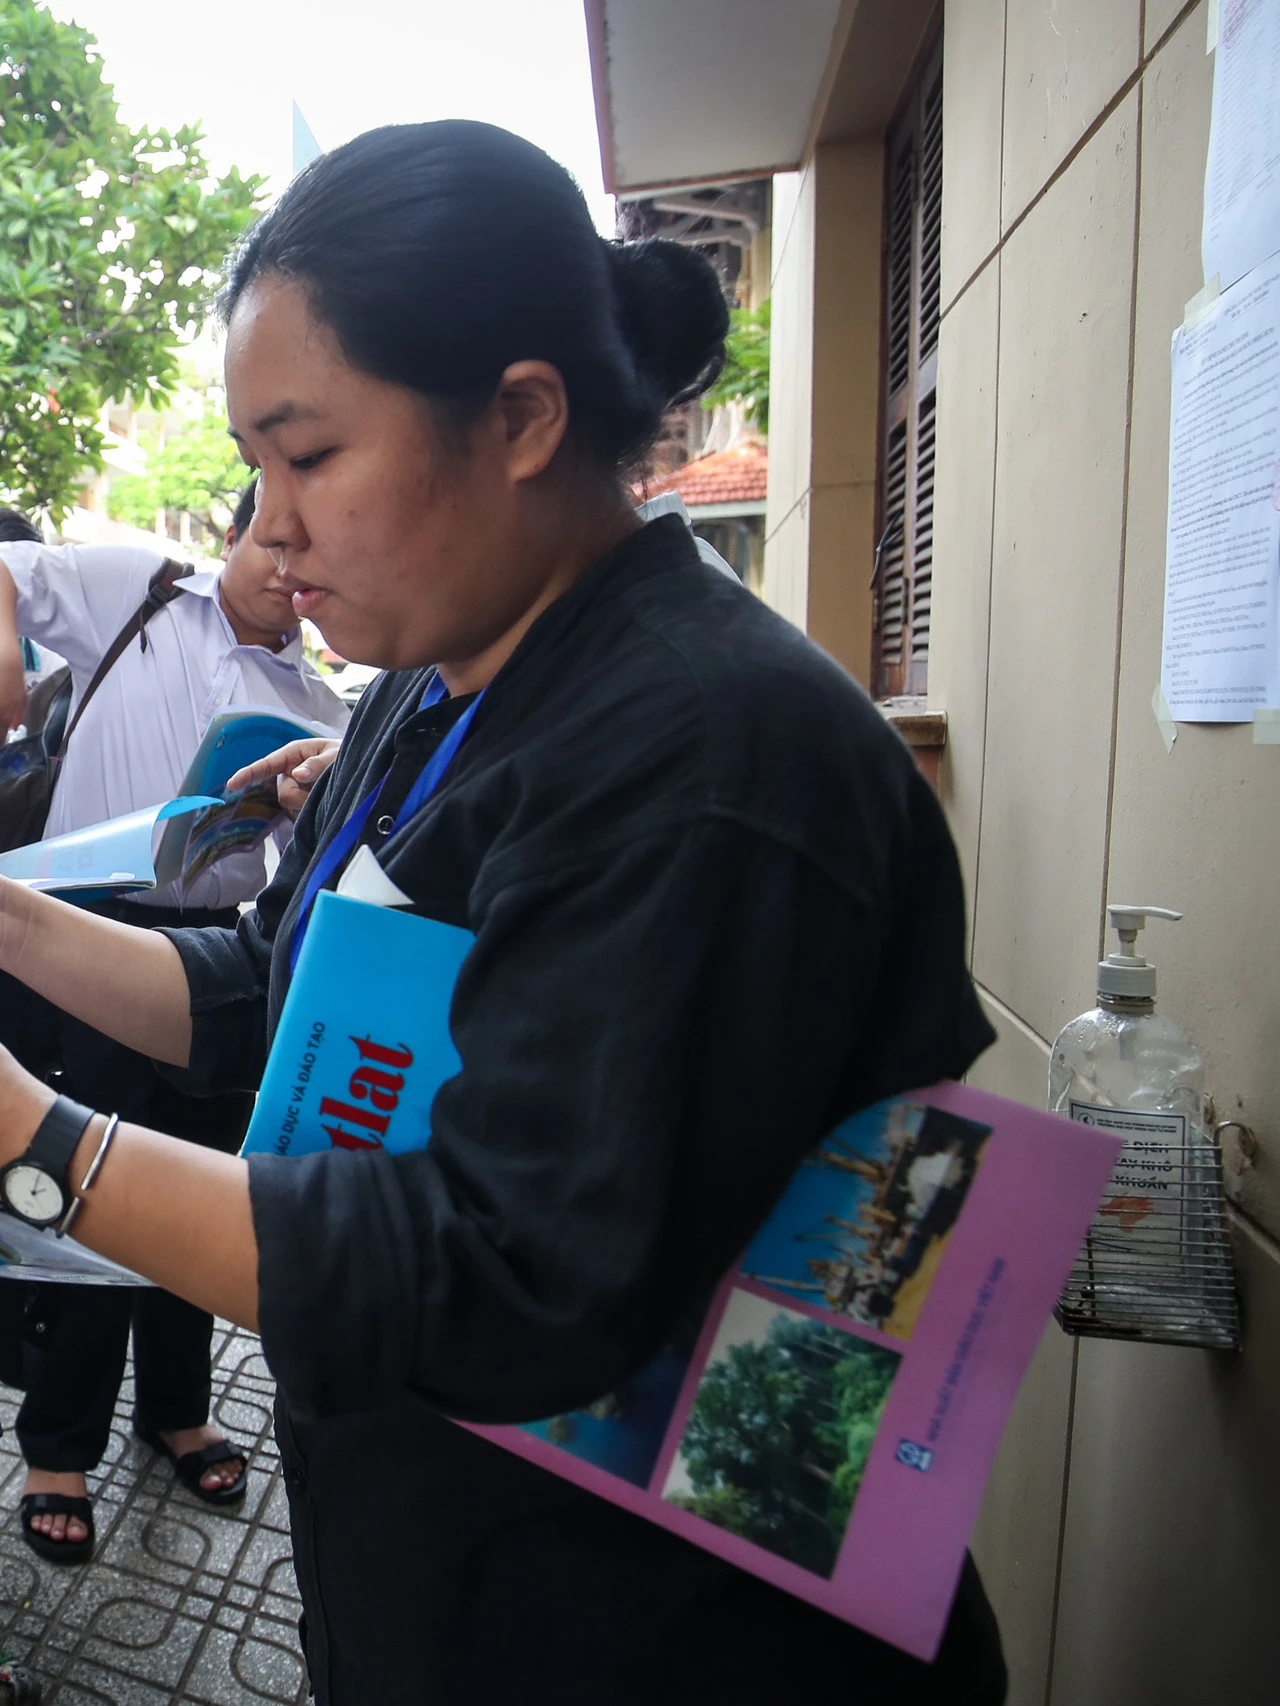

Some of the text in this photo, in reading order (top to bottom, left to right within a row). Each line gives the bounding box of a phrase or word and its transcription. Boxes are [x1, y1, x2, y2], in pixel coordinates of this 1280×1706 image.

[308, 1021, 326, 1051] TẠO
[298, 1053, 317, 1084] ĐÀO
[291, 1083, 306, 1104] VÀ
[284, 1106, 300, 1135] DỤC
